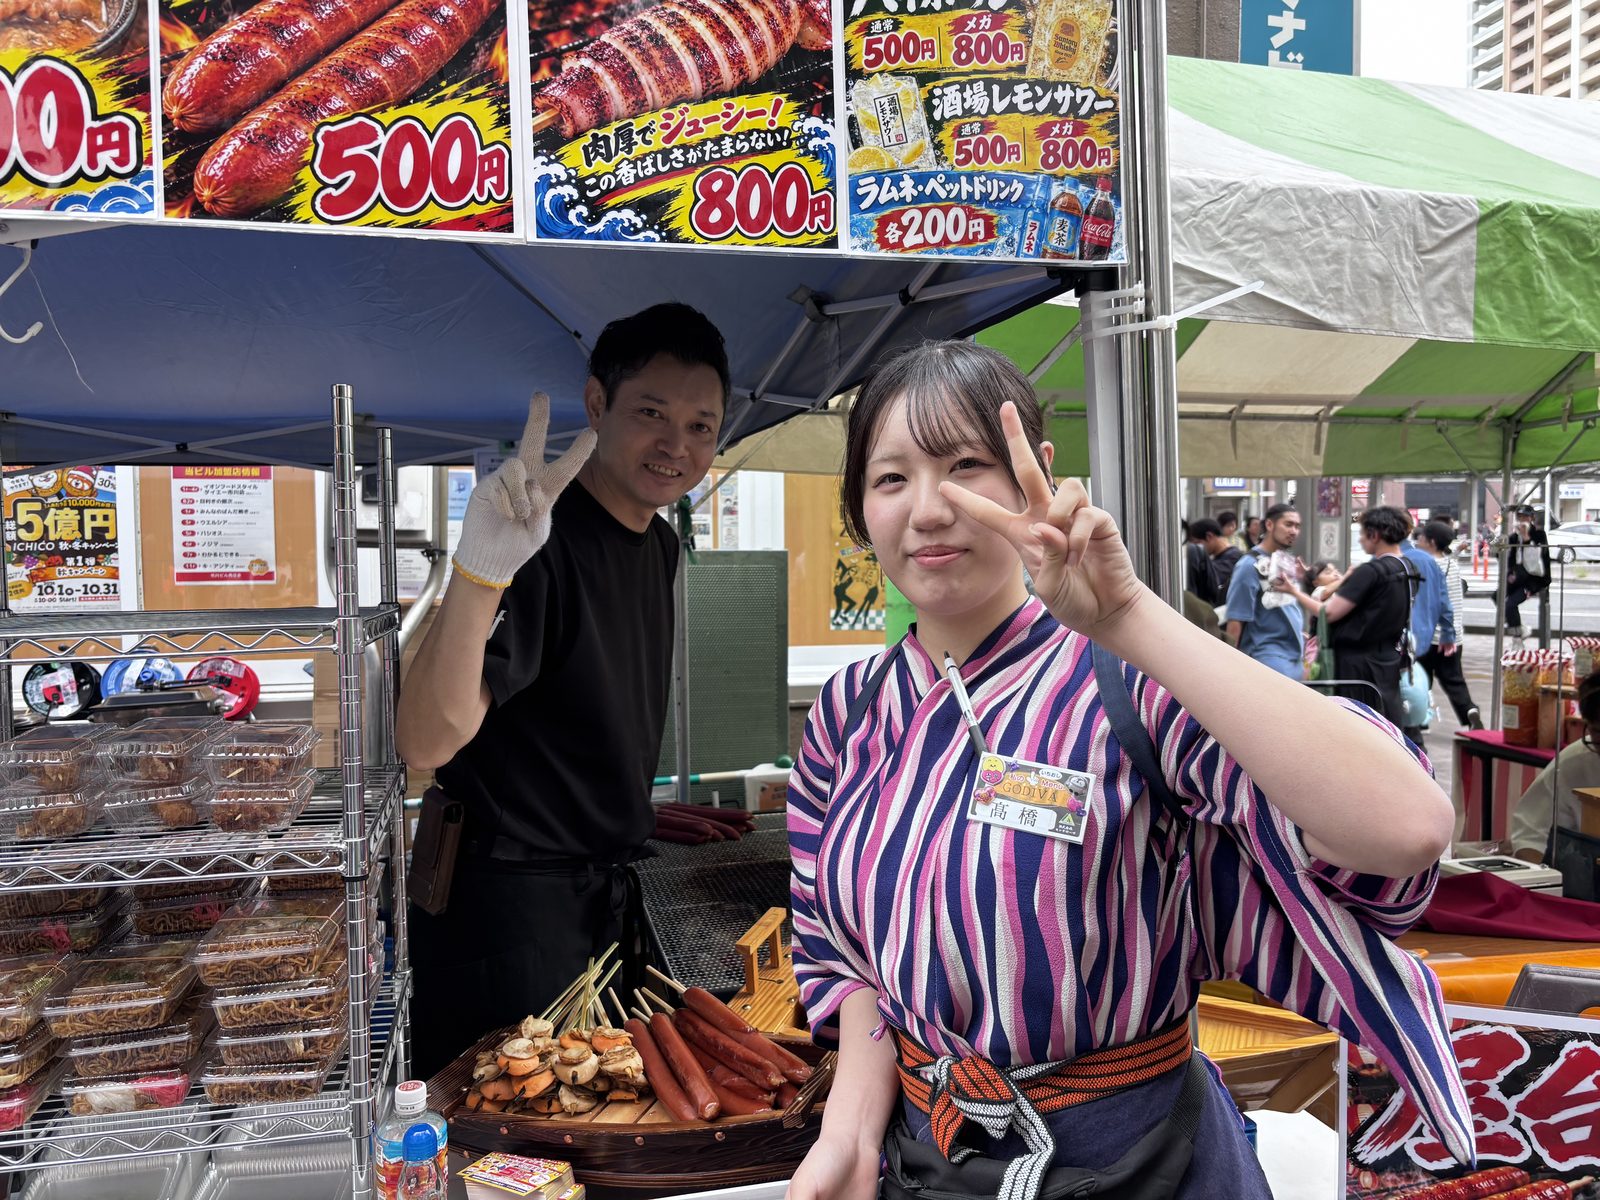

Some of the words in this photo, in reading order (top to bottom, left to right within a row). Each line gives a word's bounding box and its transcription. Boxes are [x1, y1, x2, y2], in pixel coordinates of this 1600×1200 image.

[870, 19, 894, 34] 通常
[964, 14, 992, 32] メガ
[863, 31, 936, 69] 500円
[952, 32, 1024, 66] 800円
[932, 81, 1115, 120] 酒場レモンサワー
[0, 64, 131, 177] 0円
[961, 124, 981, 136] 通常
[1051, 123, 1073, 136] メガ
[317, 118, 507, 217] 500円
[584, 128, 792, 197] この香ばしさがたまらない!
[954, 134, 1021, 167] 500円
[1040, 137, 1112, 171] 800円
[694, 166, 831, 236] 800円
[856, 175, 1025, 210] ラムネ・ペットドリンク
[884, 206, 985, 245] 各200円
[1024, 221, 1038, 253] ラムネ
[17, 501, 118, 541] 5億円
[1002, 782, 1058, 803] GODIVA
